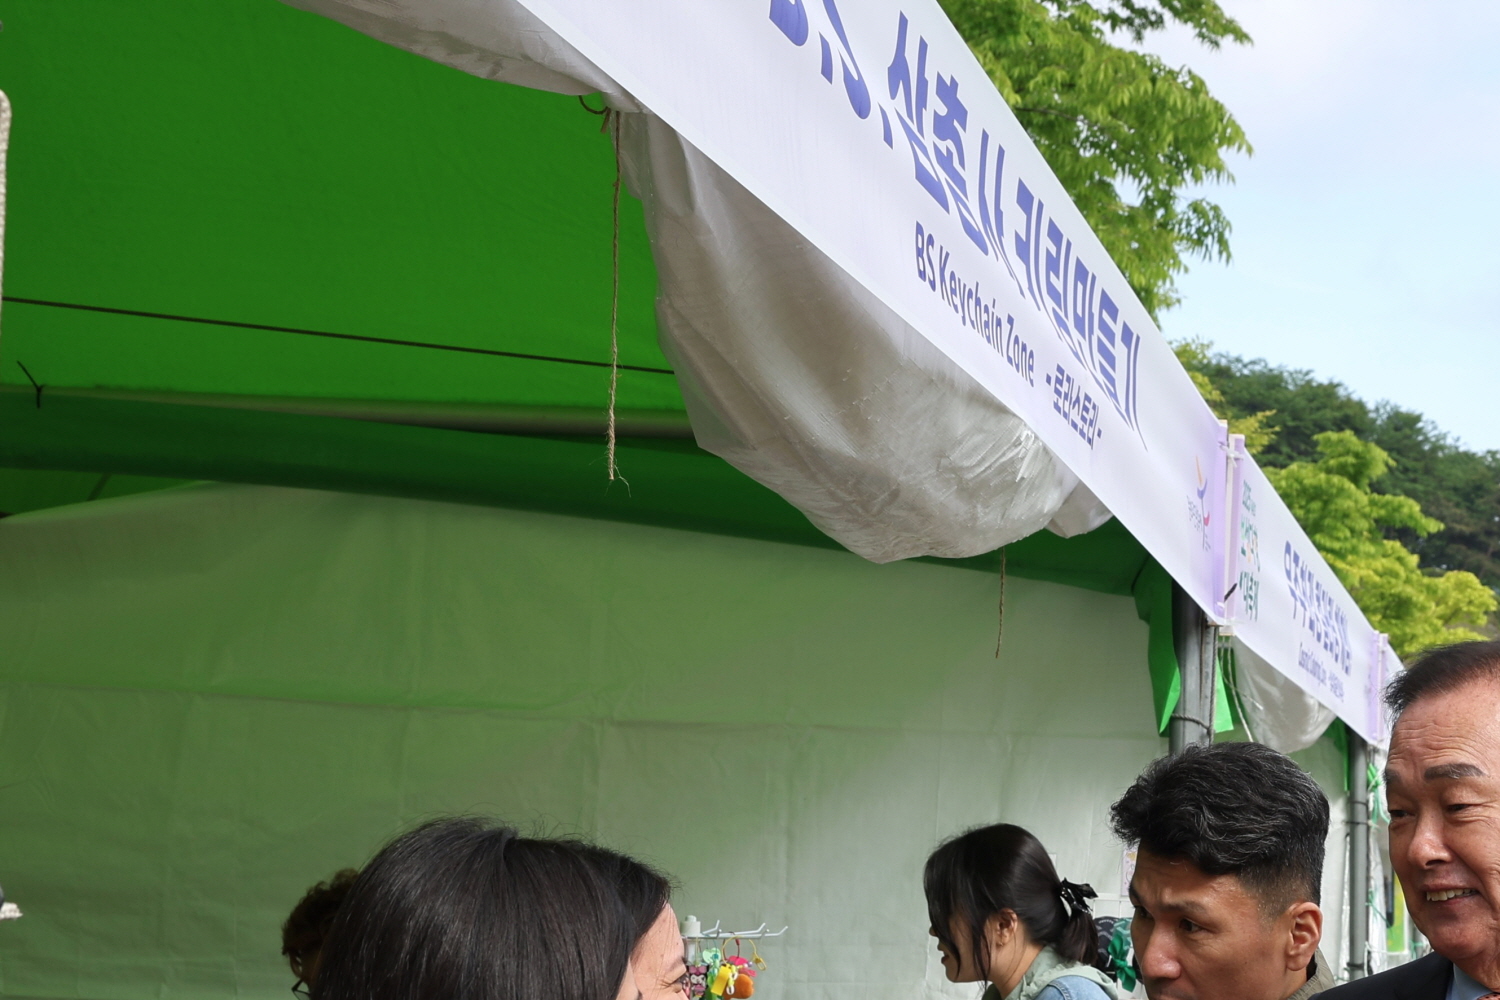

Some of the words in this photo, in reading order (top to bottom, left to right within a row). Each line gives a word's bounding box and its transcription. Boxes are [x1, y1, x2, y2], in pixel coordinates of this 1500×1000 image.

[887, 10, 1026, 299] 삼총사
[1015, 177, 1148, 452] 키링만들기
[915, 220, 937, 293] BS
[938, 244, 1004, 358] Keychain
[1006, 312, 1035, 388] Zone
